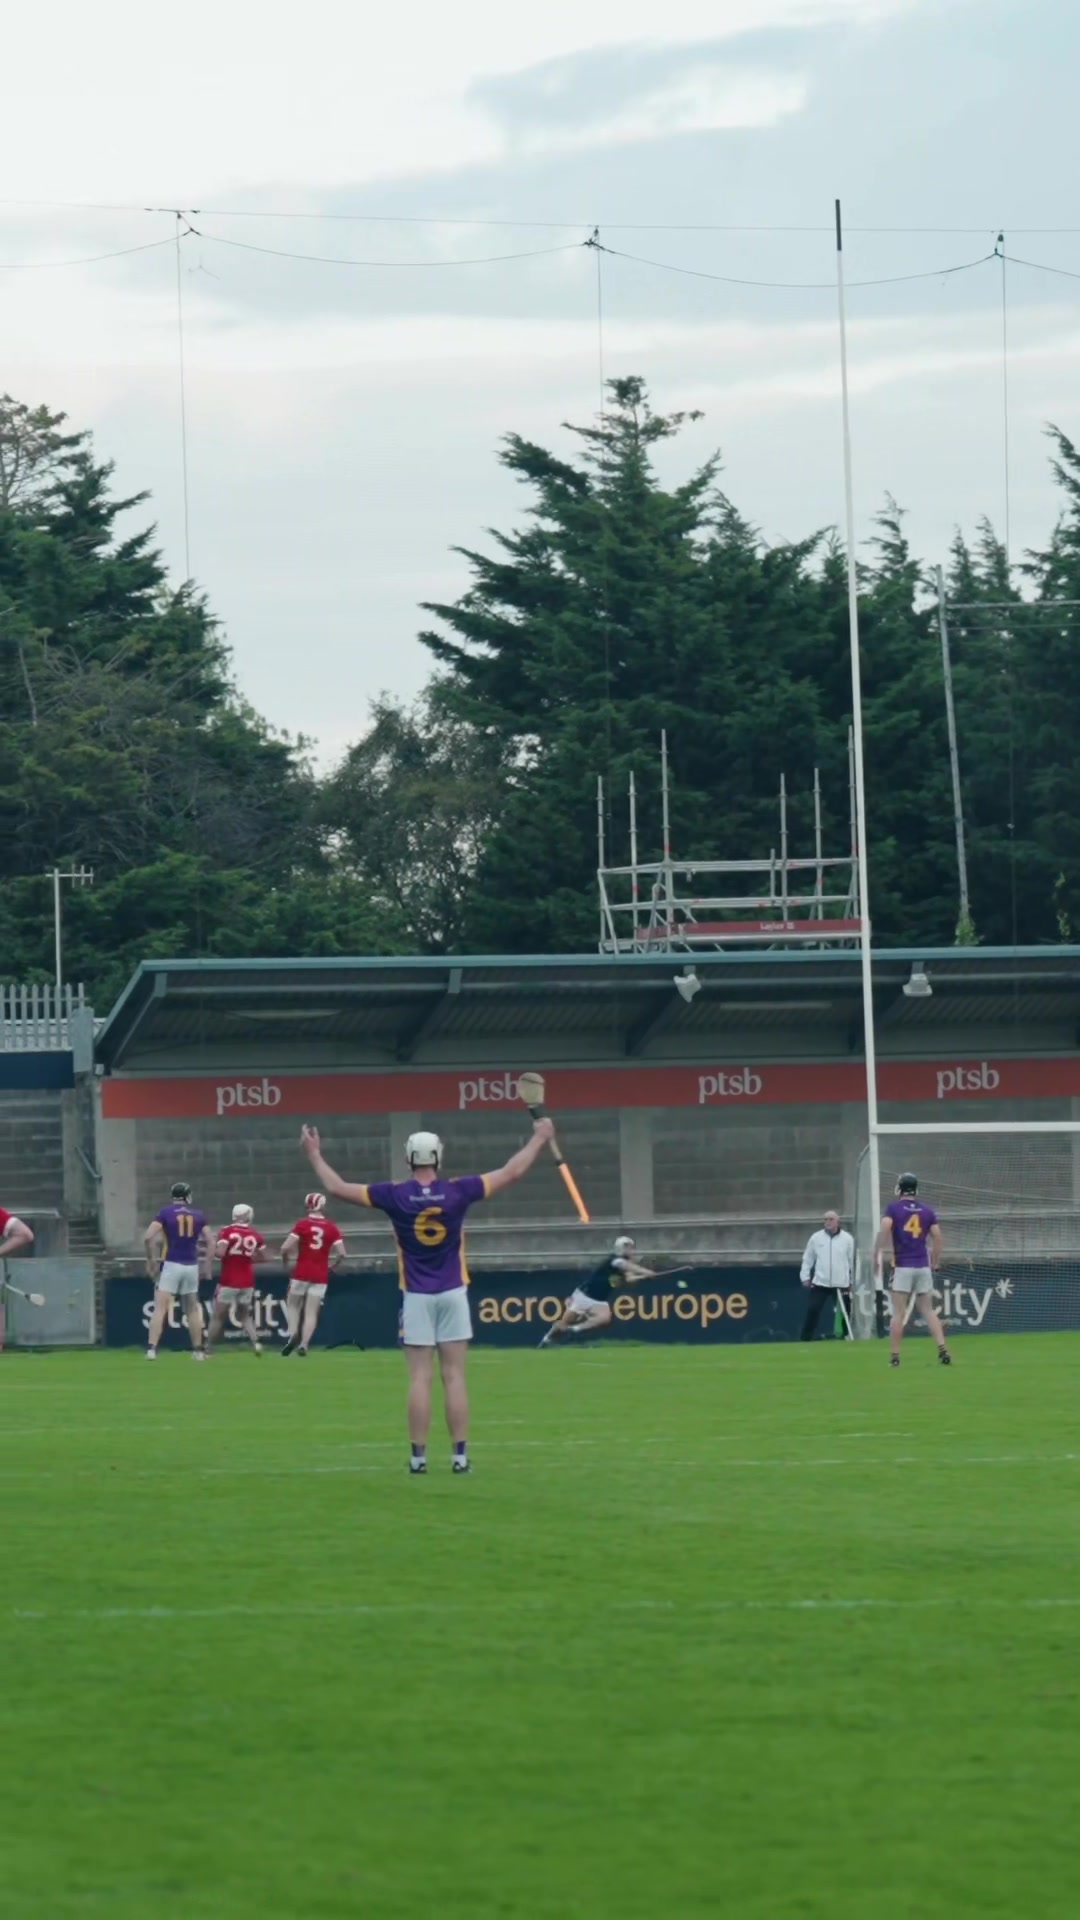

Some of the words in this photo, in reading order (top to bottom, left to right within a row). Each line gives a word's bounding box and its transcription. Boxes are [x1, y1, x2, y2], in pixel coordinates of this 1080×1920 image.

[216, 1078, 281, 1115] ptsb
[458, 1072, 521, 1110] ptsb
[698, 1067, 762, 1104] ptsb
[936, 1062, 1000, 1099] ptsb
[176, 1214, 194, 1237] 11
[309, 1226, 324, 1250] 3
[414, 1206, 447, 1246] 6
[903, 1213, 922, 1239] 4
[229, 1232, 257, 1256] 29
[479, 1296, 565, 1323] acro
[613, 1293, 748, 1328] europe
